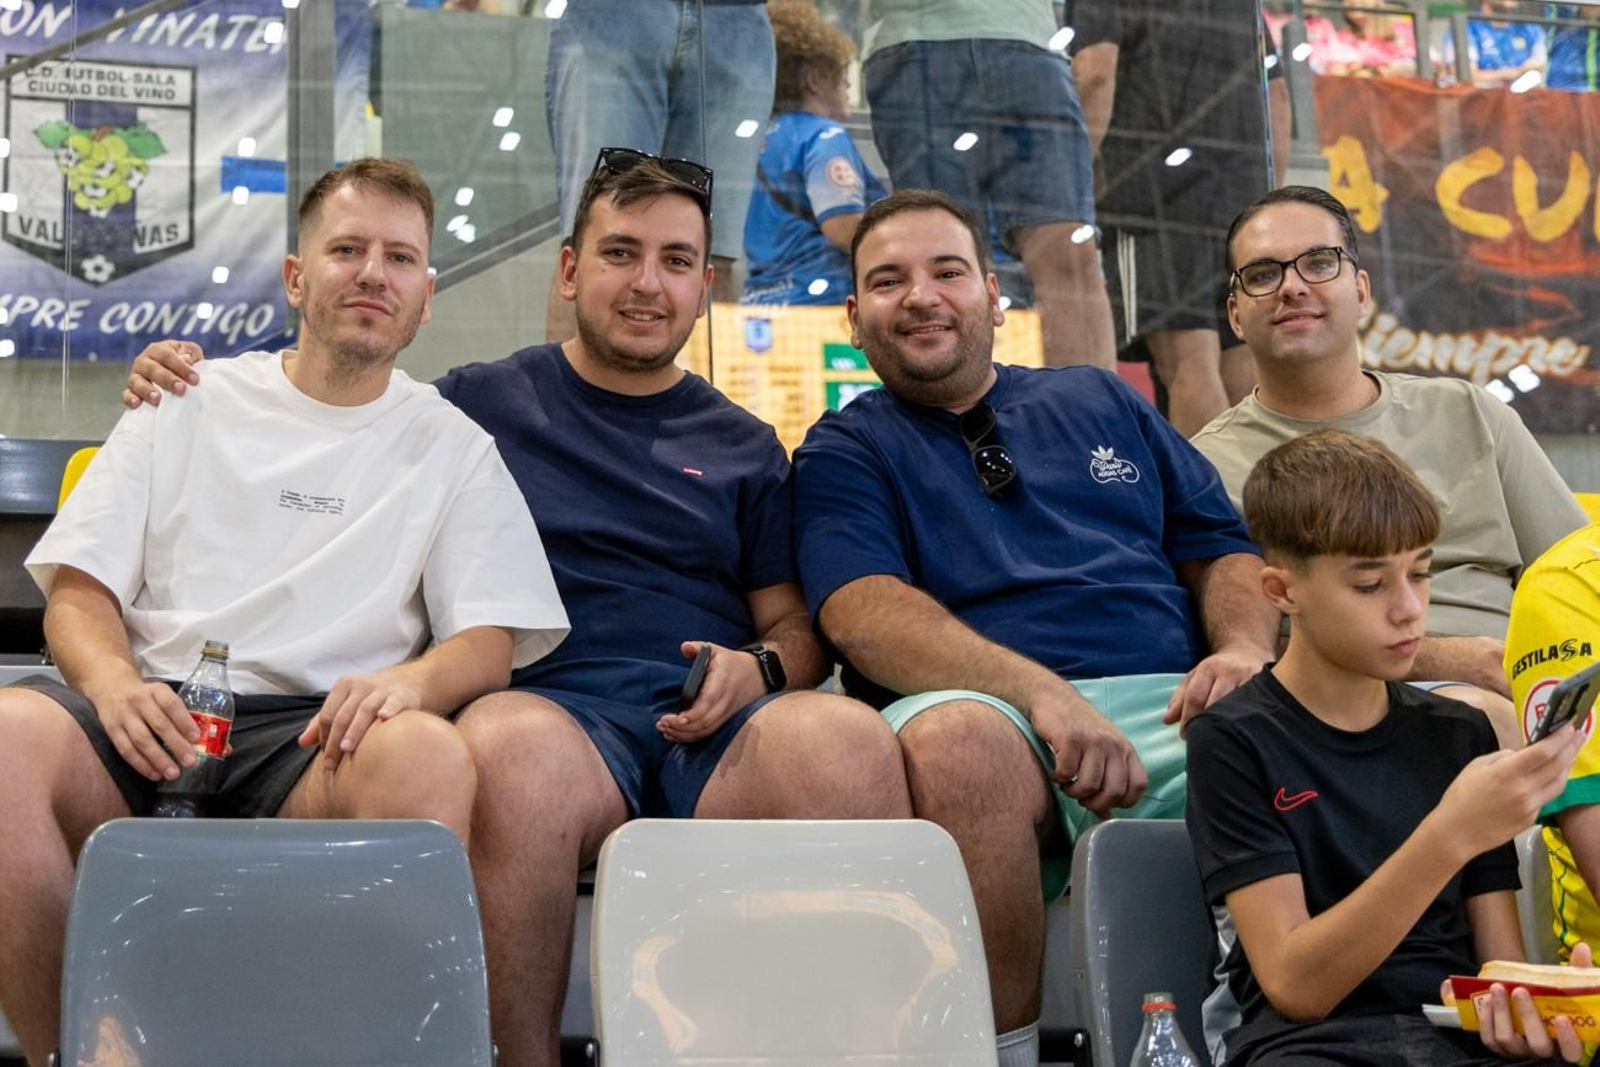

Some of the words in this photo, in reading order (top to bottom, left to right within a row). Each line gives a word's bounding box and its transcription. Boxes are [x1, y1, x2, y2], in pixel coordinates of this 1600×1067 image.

[28, 80, 91, 95] CIUDAD
[97, 84, 129, 98] DEL
[133, 87, 176, 101] VINO
[133, 72, 176, 86] SALA
[1435, 145, 1600, 243] CU
[99, 302, 275, 346] CONTIGO
[1358, 300, 1591, 388] iempre
